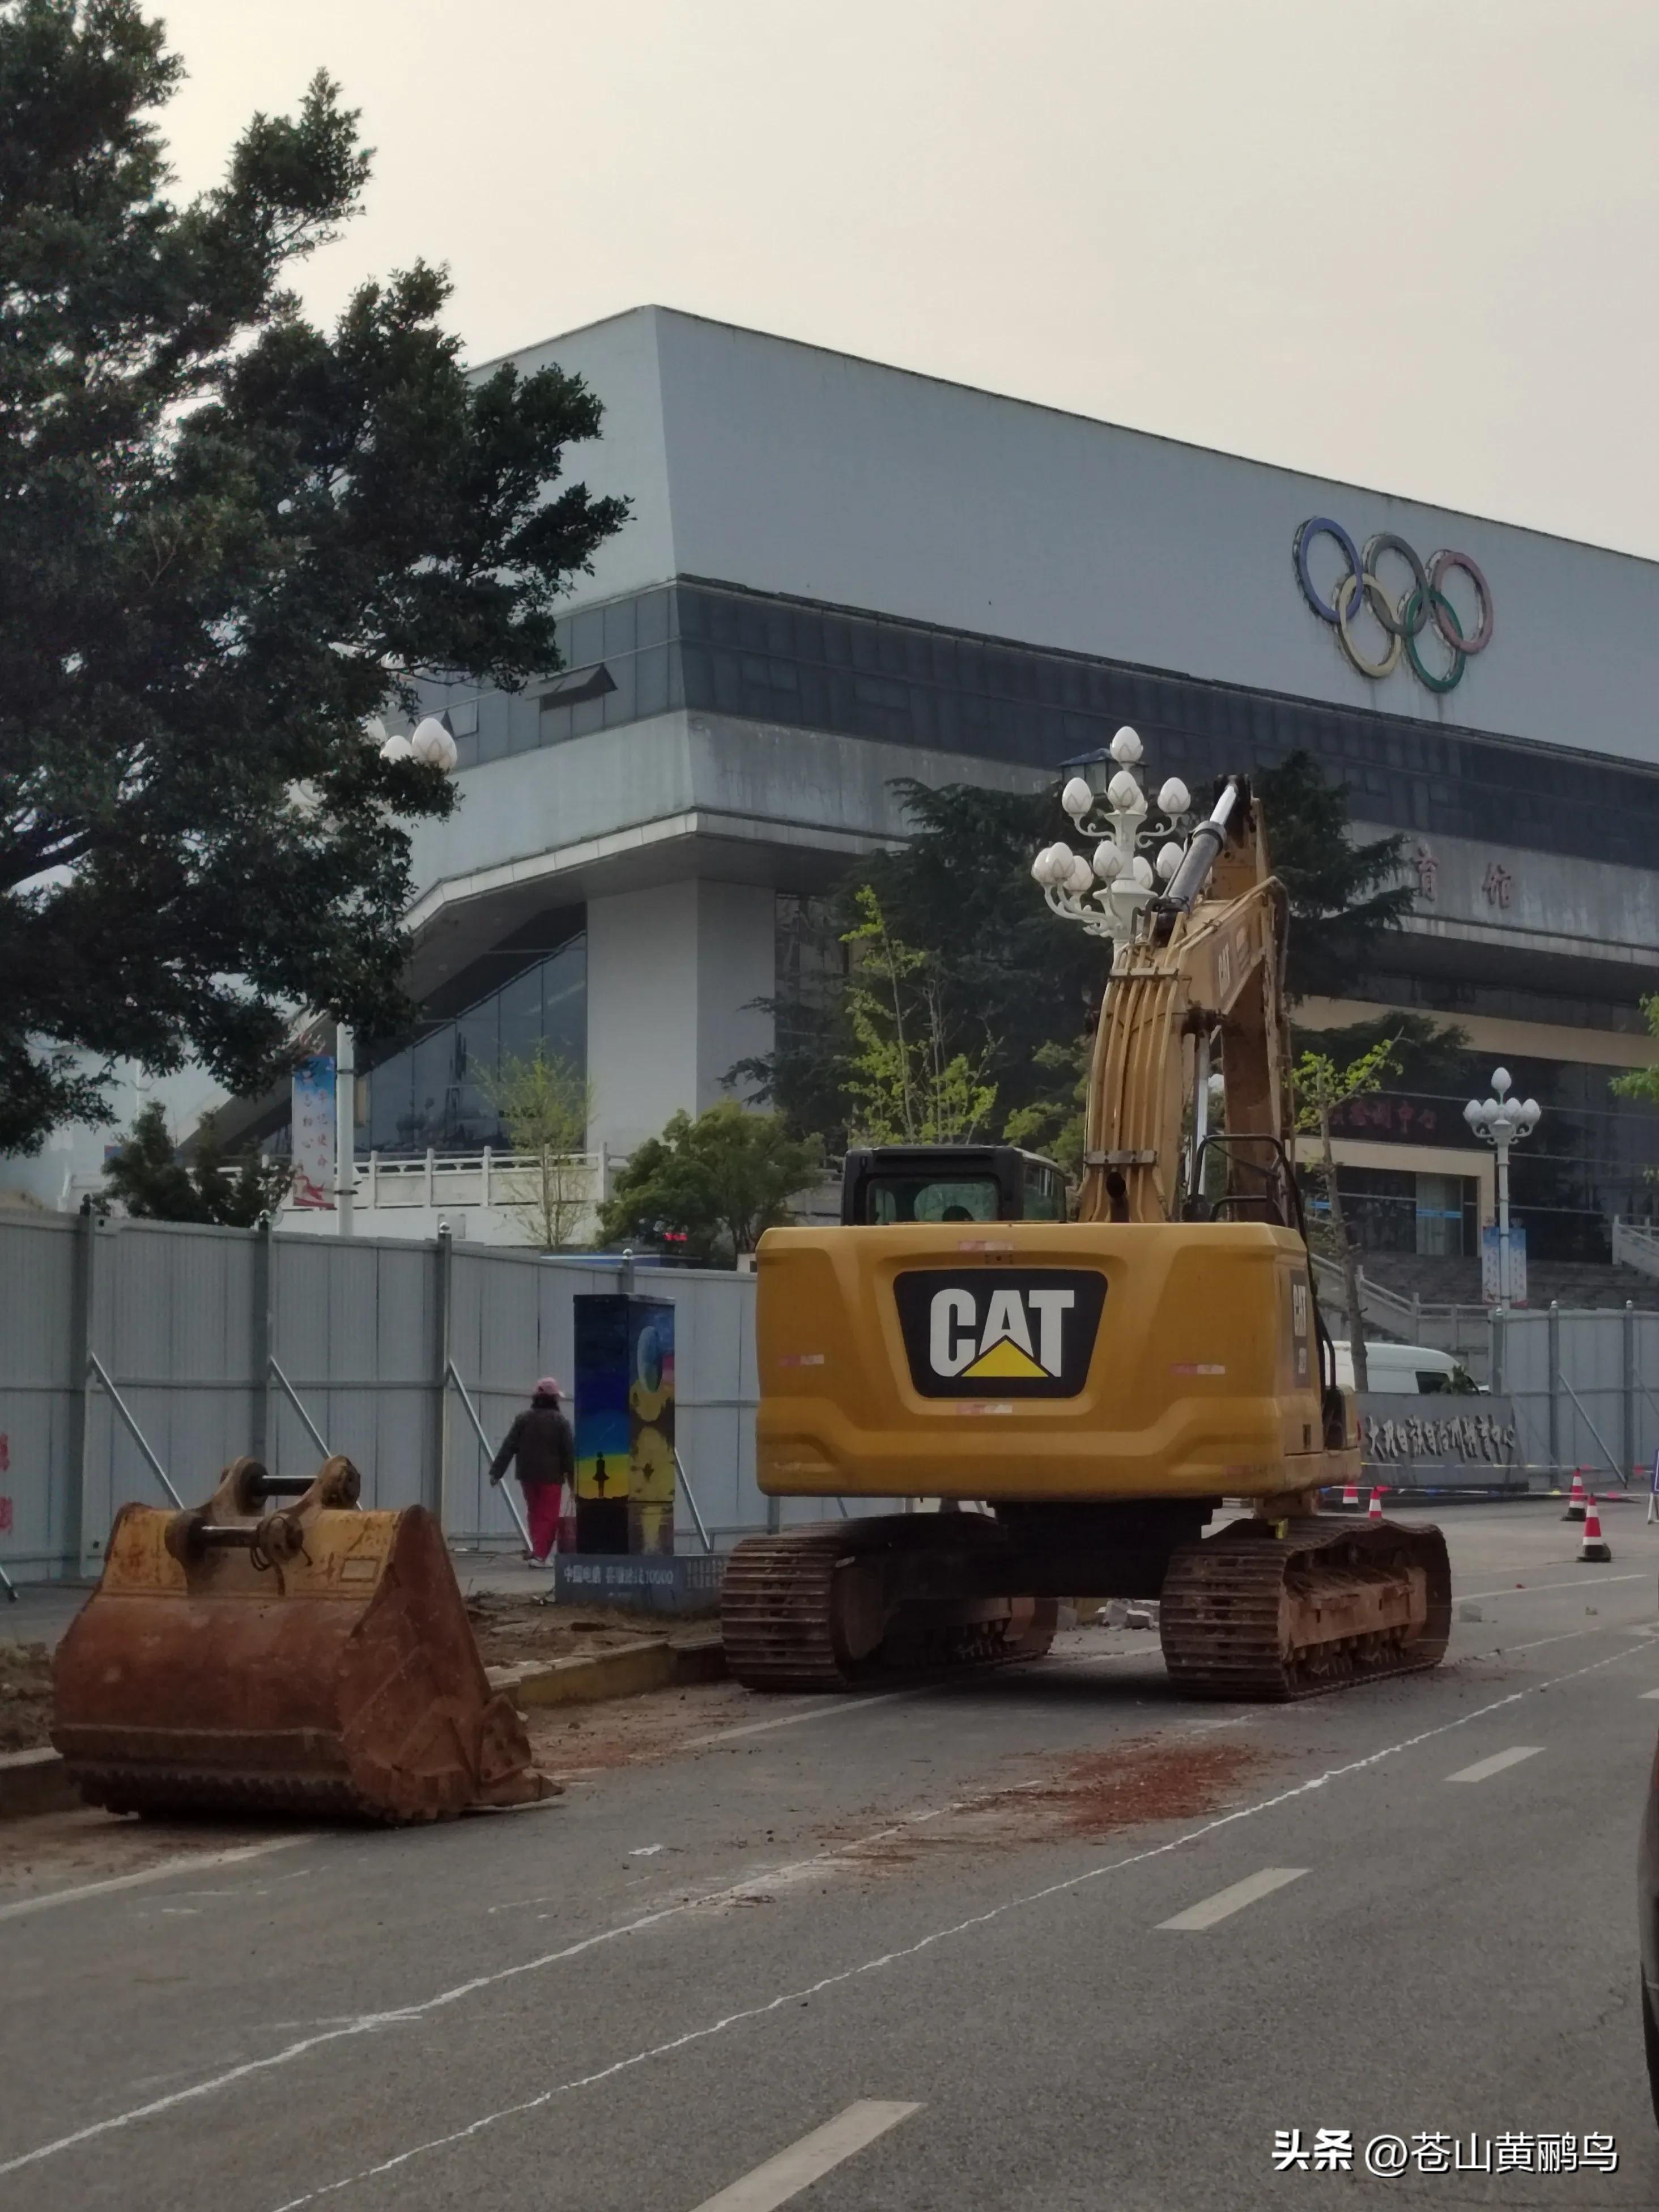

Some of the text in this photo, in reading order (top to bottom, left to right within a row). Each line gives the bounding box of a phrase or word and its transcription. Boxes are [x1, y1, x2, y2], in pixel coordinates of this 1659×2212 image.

[930, 1288, 1074, 1377] CAT
[563, 1564, 601, 1584] 中国电信
